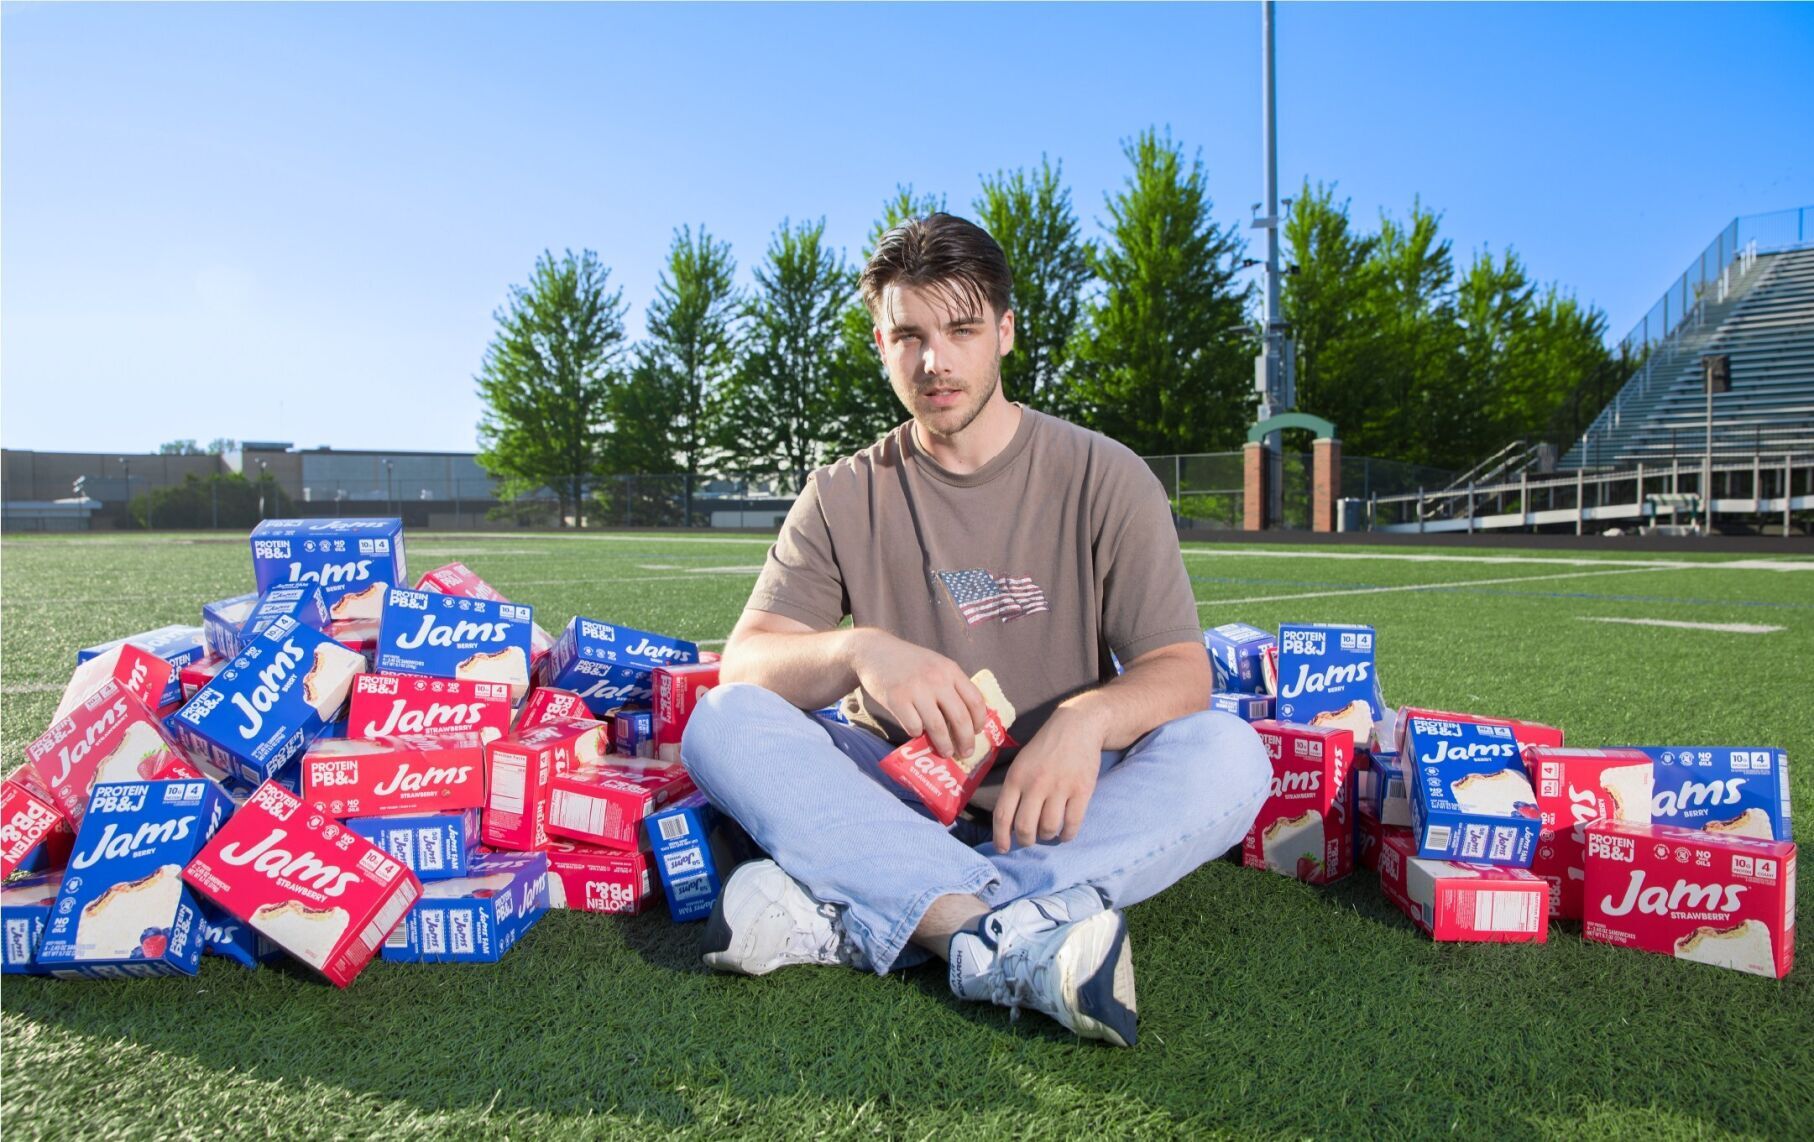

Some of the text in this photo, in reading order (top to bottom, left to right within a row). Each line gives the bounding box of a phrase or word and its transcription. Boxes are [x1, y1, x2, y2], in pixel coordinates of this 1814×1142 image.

[255, 541, 290, 550] PROTEIN
[257, 548, 291, 559] PB&J
[389, 598, 428, 610] PB&J
[391, 590, 428, 600] PROTEIN
[396, 614, 510, 649] Jams
[582, 621, 614, 632] PROTEIN
[583, 629, 615, 642] PB&J
[1284, 631, 1326, 641] PROTEIN
[626, 638, 692, 662] Jams
[1283, 641, 1326, 656] PB&J
[574, 664, 610, 676] PB&J
[577, 660, 612, 670] PROTEIN
[231, 638, 304, 739] Jams
[359, 676, 399, 685] PROTEIN
[1282, 661, 1371, 698] Jams
[357, 684, 398, 695] PB&J
[181, 688, 215, 718] PROTEIN
[187, 690, 224, 725] PB&J
[660, 675, 669, 723] PB&J
[364, 699, 486, 738] Jams
[1414, 720, 1460, 730] PROTEIN
[29, 717, 71, 751] PROTEIN
[31, 718, 76, 761] PB&J
[988, 720, 1005, 746] PB&J
[1416, 726, 1462, 737] PB&J
[51, 697, 127, 788] Jams
[266, 728, 303, 768] PROTEIN
[267, 734, 304, 777] PB&J
[1421, 741, 1516, 763] Jams
[311, 761, 358, 772] PROTEIN
[900, 747, 965, 796] Jams
[1546, 767, 1552, 775] 4
[311, 770, 358, 787] PB&J
[374, 764, 473, 796] Jams
[910, 766, 942, 797] STRAWBERRY
[1268, 771, 1322, 797] ams
[1332, 744, 1345, 824] Jams
[96, 785, 149, 796] PROTEIN
[190, 786, 198, 794] 4
[263, 784, 301, 809] PROTEIN
[400, 791, 438, 799] STRAWBERRY
[1651, 778, 1746, 816] ams
[90, 796, 145, 813] PB&J
[252, 791, 296, 822] PB&J
[1684, 809, 1708, 818] BERRY
[1542, 812, 1547, 825] NO
[4, 808, 58, 864] PROTEIN
[72, 816, 197, 869] Jams
[342, 833, 355, 844] NO
[1589, 833, 1634, 849] PROTEIN
[133, 848, 156, 858] BERRY
[671, 853, 695, 868] Jams
[1519, 849, 1528, 862] FAM
[1589, 843, 1634, 863] PB&J
[1696, 850, 1711, 858] NO
[220, 829, 360, 897] Jams
[385, 865, 392, 874] 4
[1734, 857, 1751, 869] 10G
[1762, 862, 1770, 871] 4
[276, 878, 327, 902] STRAWBERRY
[518, 874, 546, 919] Jams
[586, 881, 633, 899] PB&J
[1601, 869, 1748, 916] Jams
[496, 897, 513, 925] PB&J
[586, 898, 634, 912] PROTEIN
[54, 917, 69, 926] NO
[1671, 912, 1730, 921] STRAWBERRY
[170, 904, 185, 954] PROTEIN
[173, 906, 194, 958] PB&J
[426, 917, 439, 948] Jams
[455, 917, 468, 949] Jams
